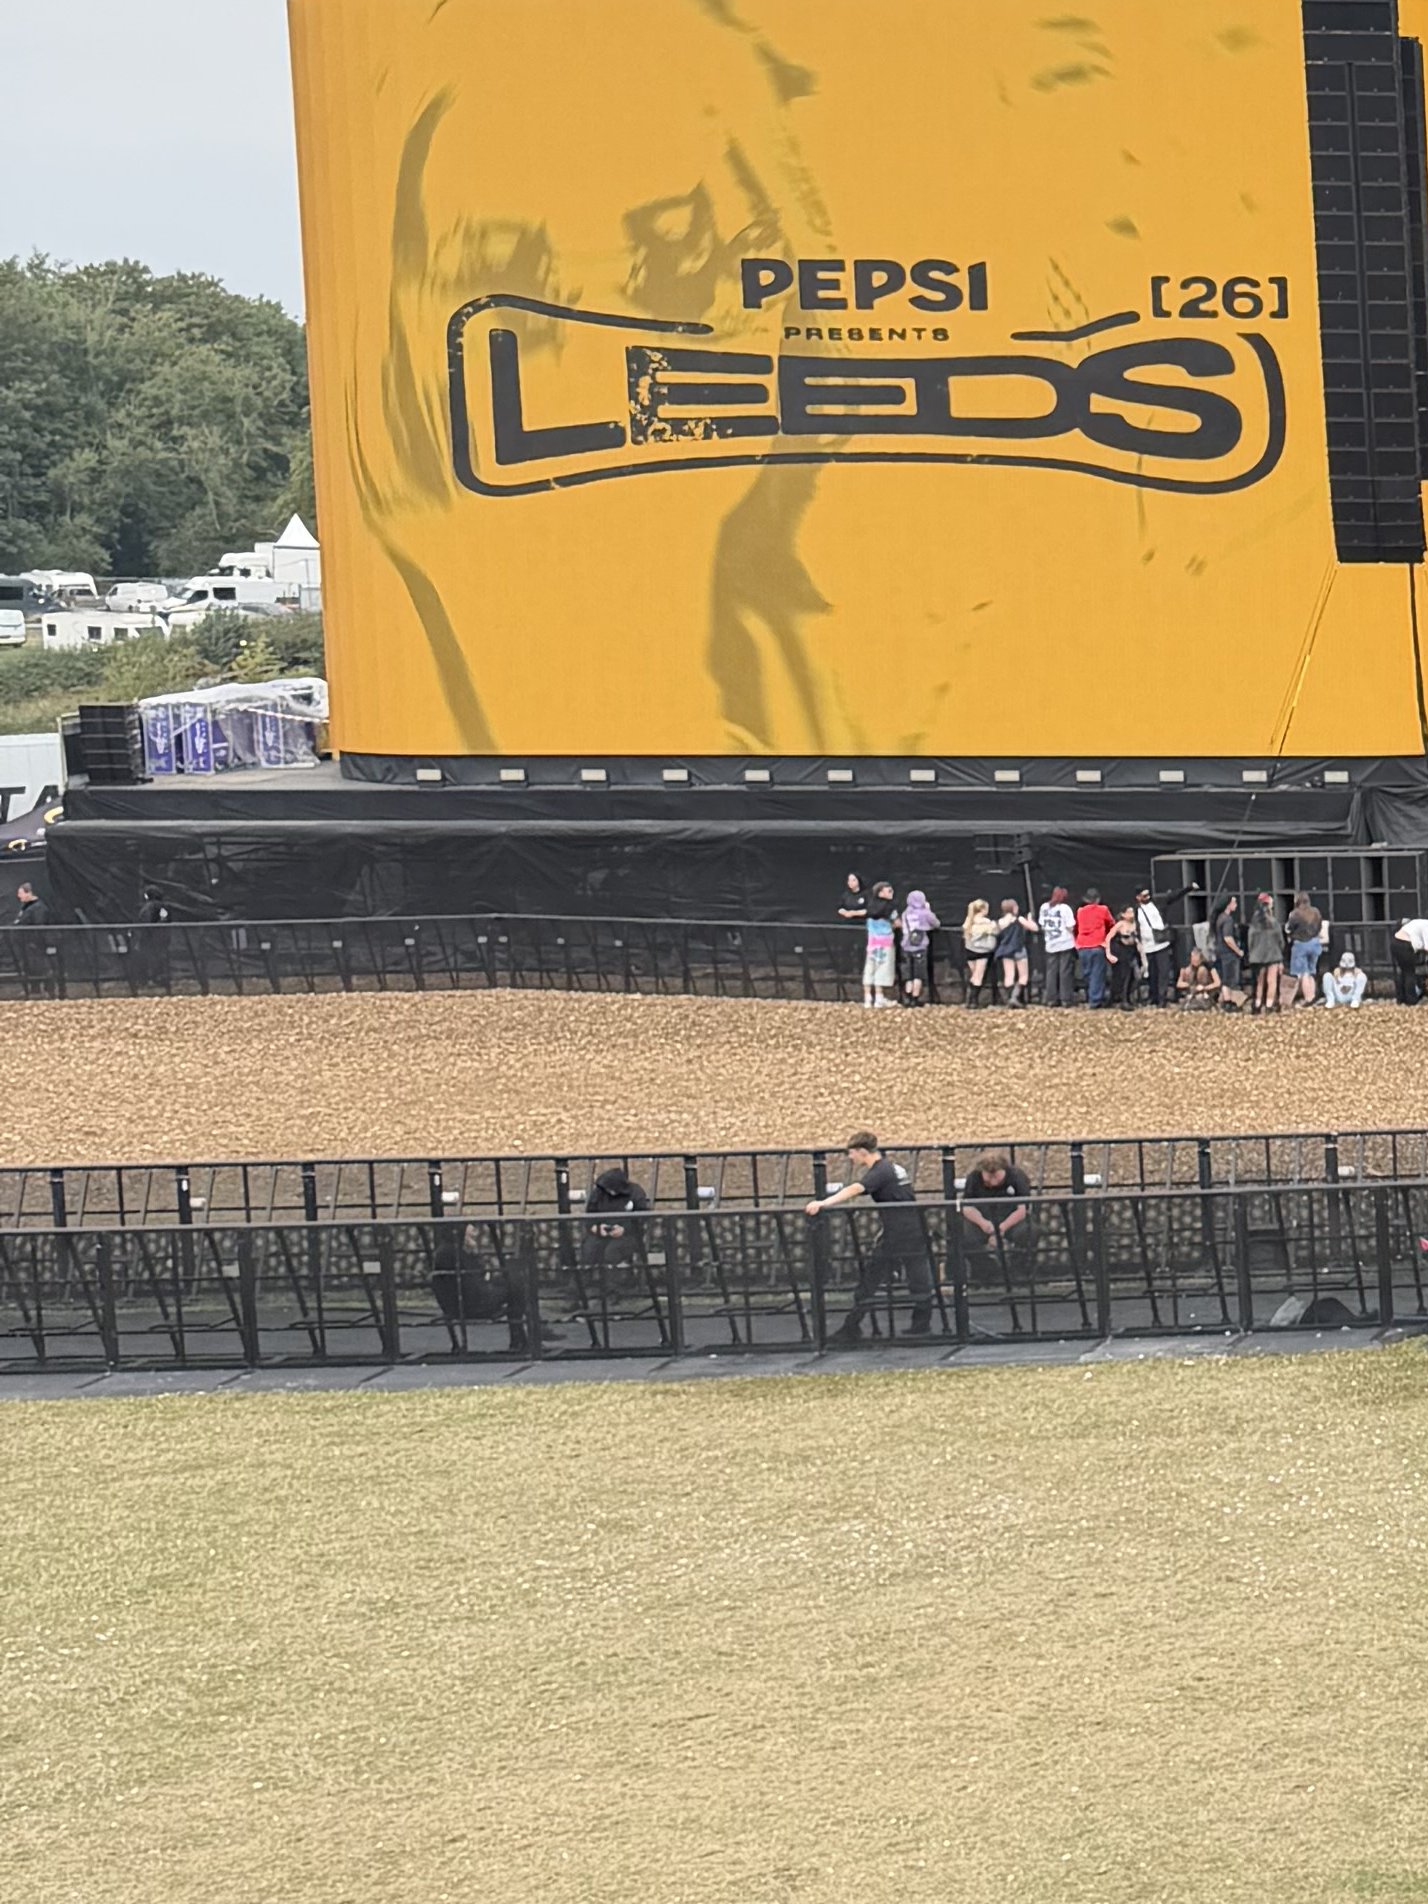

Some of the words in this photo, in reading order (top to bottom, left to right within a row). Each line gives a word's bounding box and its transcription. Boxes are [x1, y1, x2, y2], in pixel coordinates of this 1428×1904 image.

[741, 258, 988, 312] PEPSI
[1151, 276, 1289, 319] [26]
[784, 327, 950, 342] PRESENTS
[489, 329, 1242, 465] LEEDS
